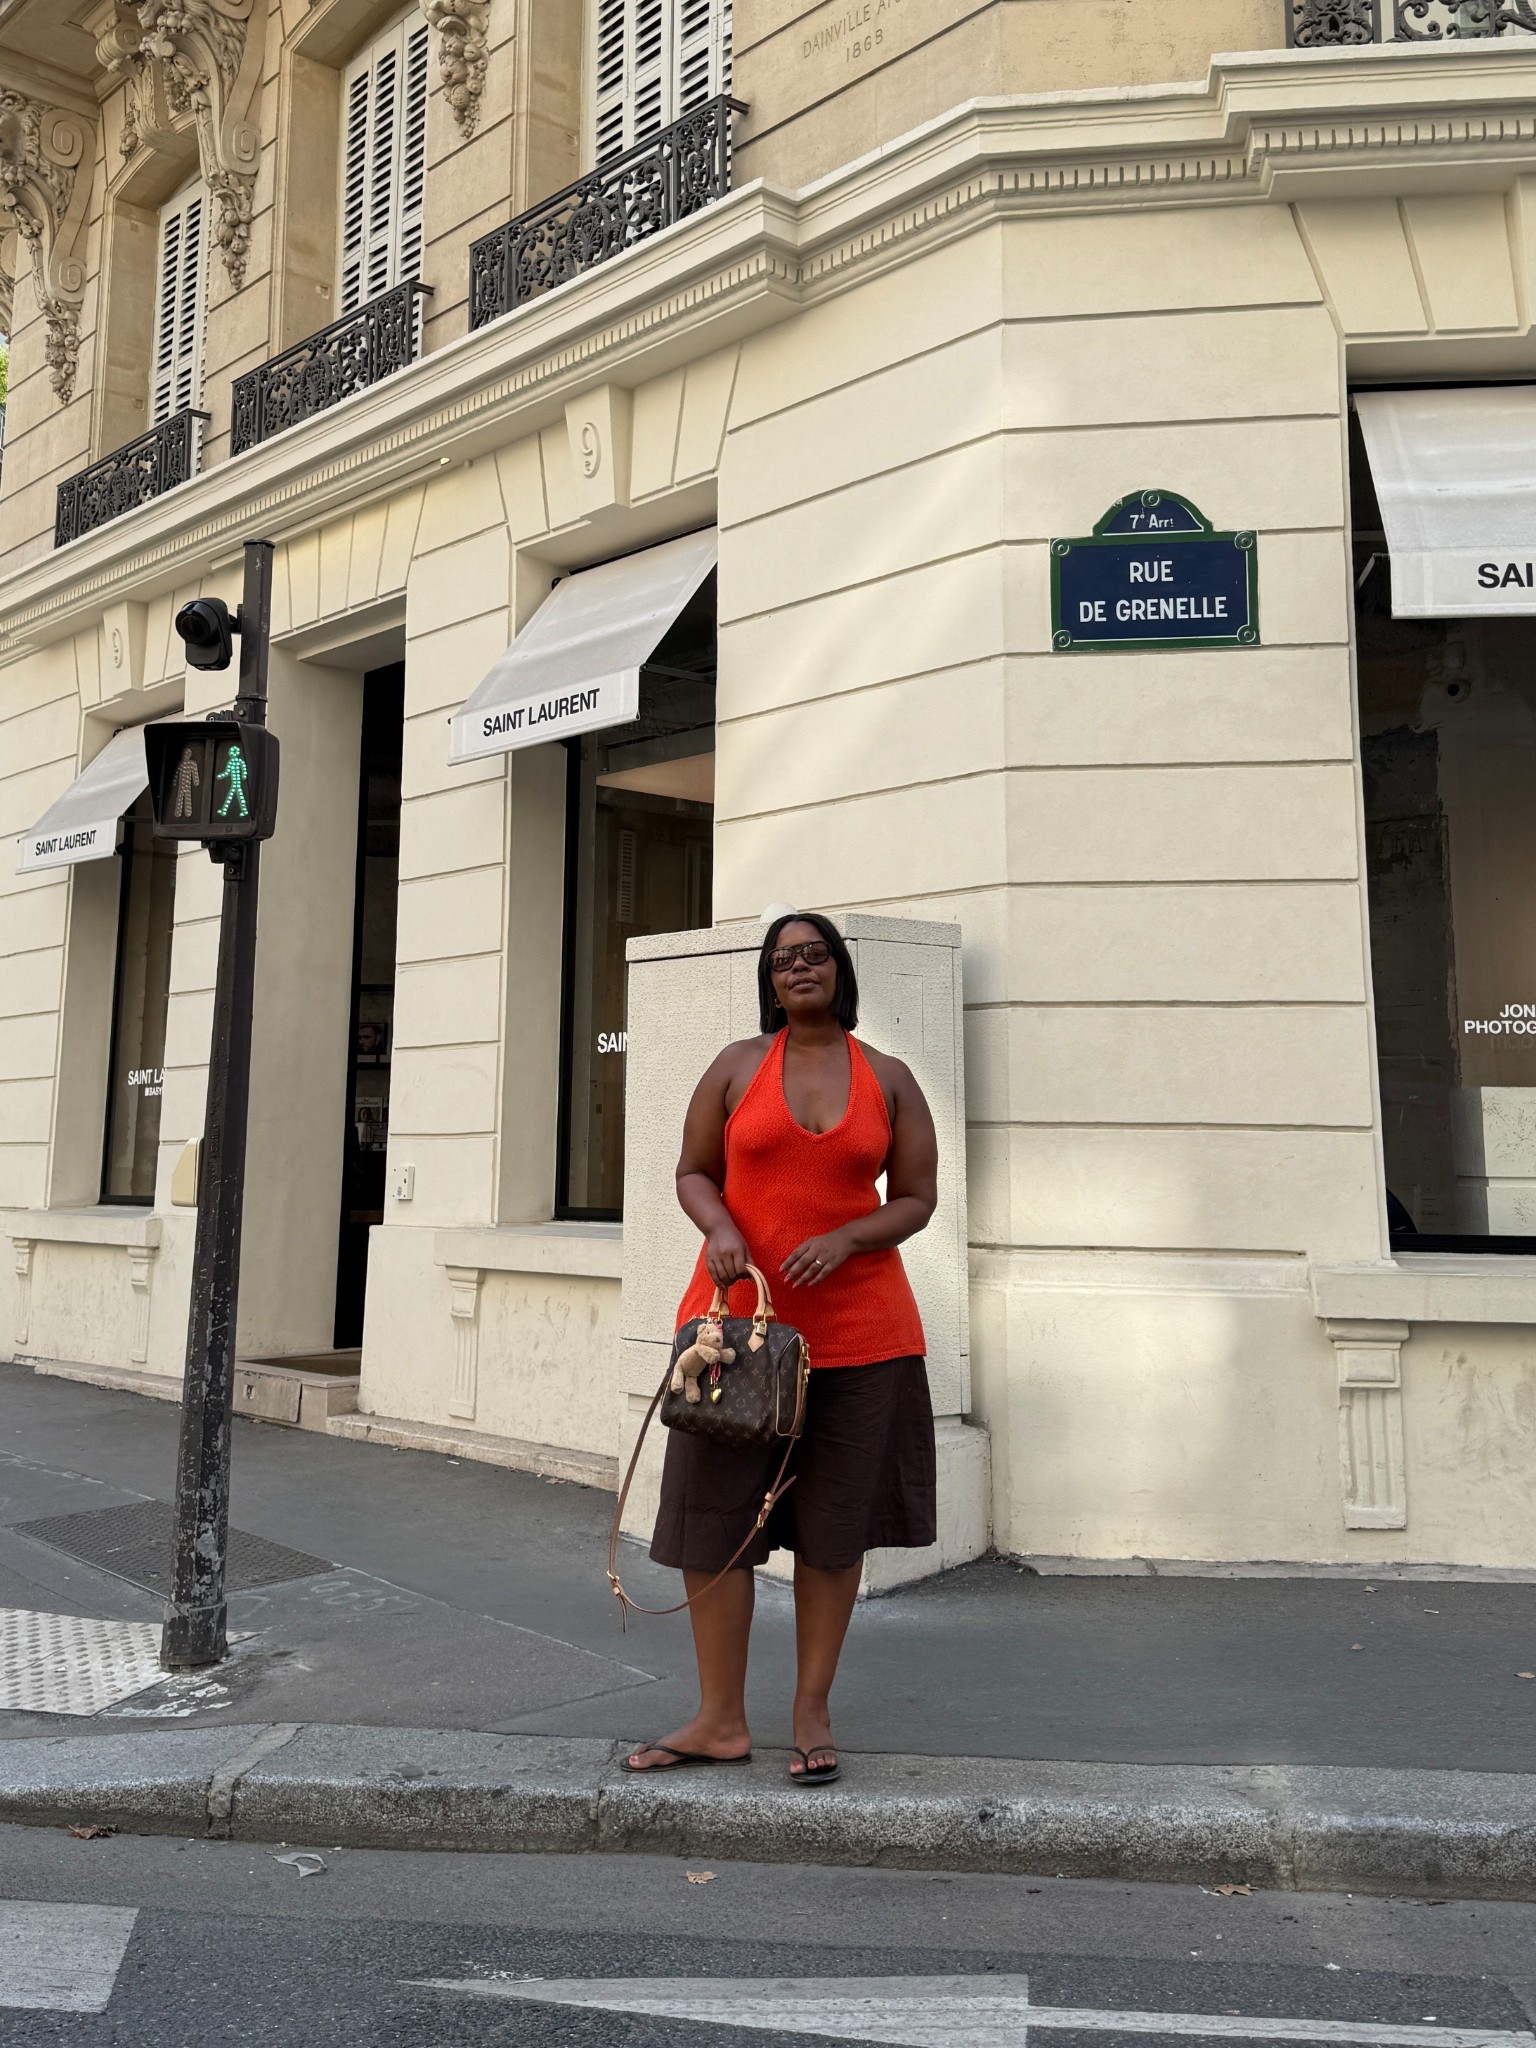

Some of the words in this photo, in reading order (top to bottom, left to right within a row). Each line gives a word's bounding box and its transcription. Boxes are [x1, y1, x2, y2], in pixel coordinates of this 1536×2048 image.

[803, 4, 871, 59] DAINVILLE
[1129, 560, 1174, 583] RUE
[1477, 562, 1534, 588] SAI
[1079, 600, 1107, 623] DE
[1115, 596, 1228, 622] GRENELLE
[483, 708, 526, 737] SAINT
[528, 687, 600, 725] LAURENT
[35, 838, 58, 856] SAINT
[58, 829, 97, 851] LAURENT
[1499, 1003, 1536, 1018] JON
[1463, 1019, 1536, 1035] PHOTOG
[127, 1068, 153, 1086] SAINT
